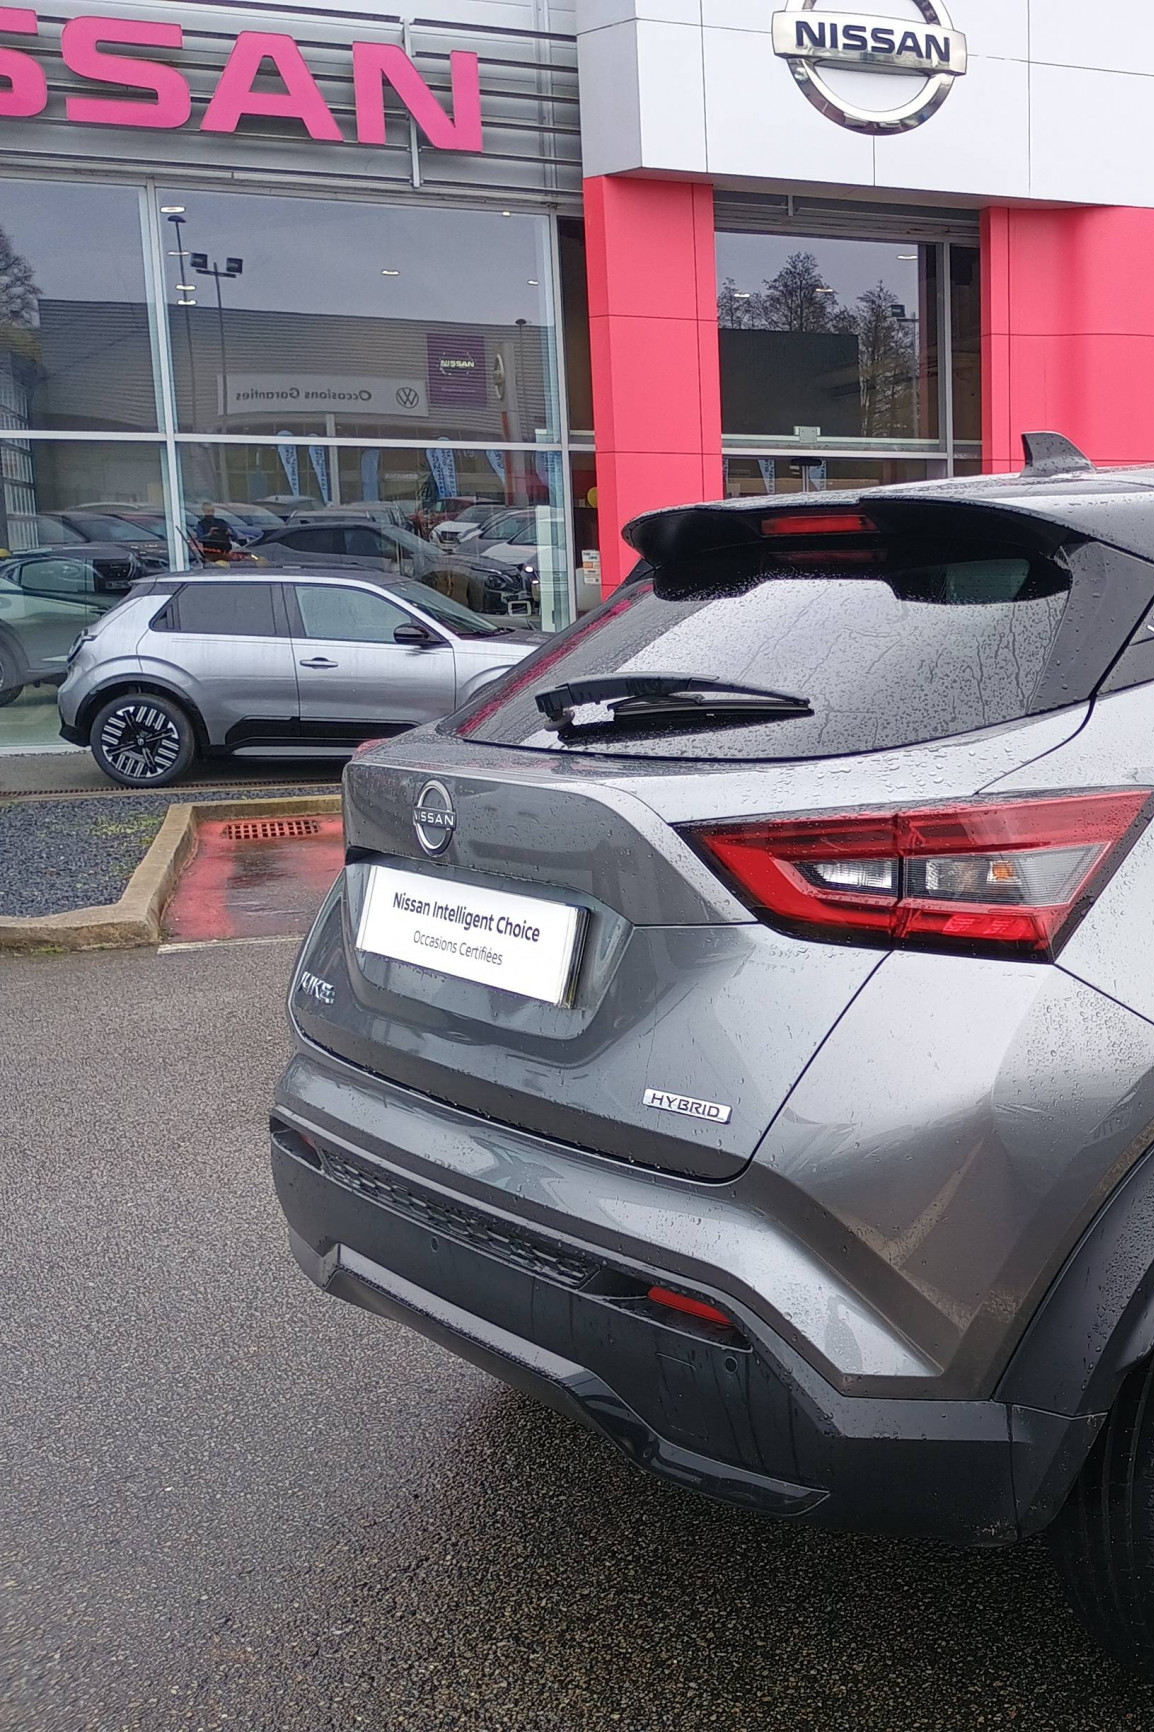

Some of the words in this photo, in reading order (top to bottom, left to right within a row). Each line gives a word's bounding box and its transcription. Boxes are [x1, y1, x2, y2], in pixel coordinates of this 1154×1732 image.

[795, 20, 950, 62] NISSAN
[393, 891, 430, 917] Nissan
[432, 901, 494, 933] Intelligent
[496, 916, 540, 943] Choice
[413, 930, 457, 954] Occasions
[459, 941, 503, 966] Certifiées
[651, 1092, 720, 1118] HYBRID
